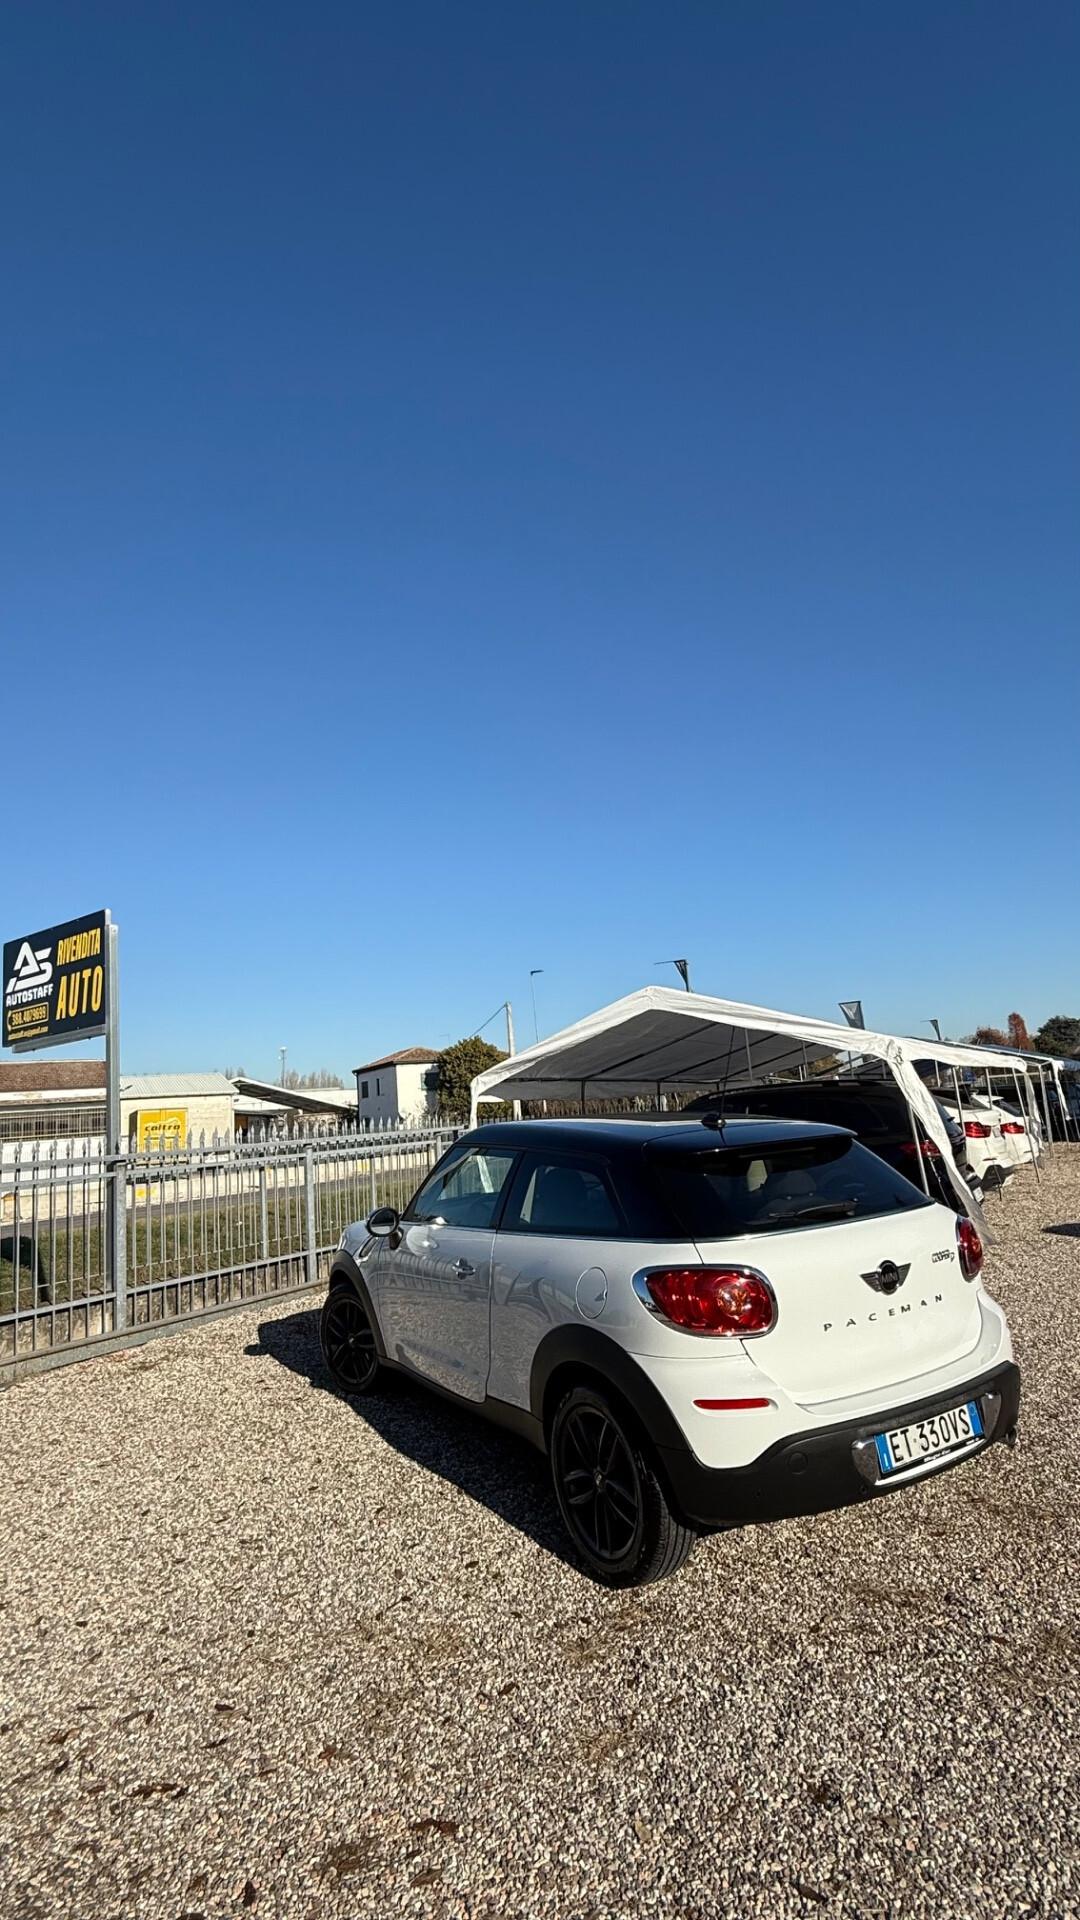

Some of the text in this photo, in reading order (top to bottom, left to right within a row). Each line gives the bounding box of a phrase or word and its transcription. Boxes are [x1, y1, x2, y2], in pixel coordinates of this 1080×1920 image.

[57, 928, 101, 966] RIVENDITA
[6, 984, 53, 1007] AUTOSTAFF
[56, 965, 103, 1020] AUTO
[881, 1273, 898, 1283] MINI
[823, 1294, 943, 1331] PACEMAN
[889, 1428, 912, 1463] ET
[916, 1408, 970, 1452] 330VS
